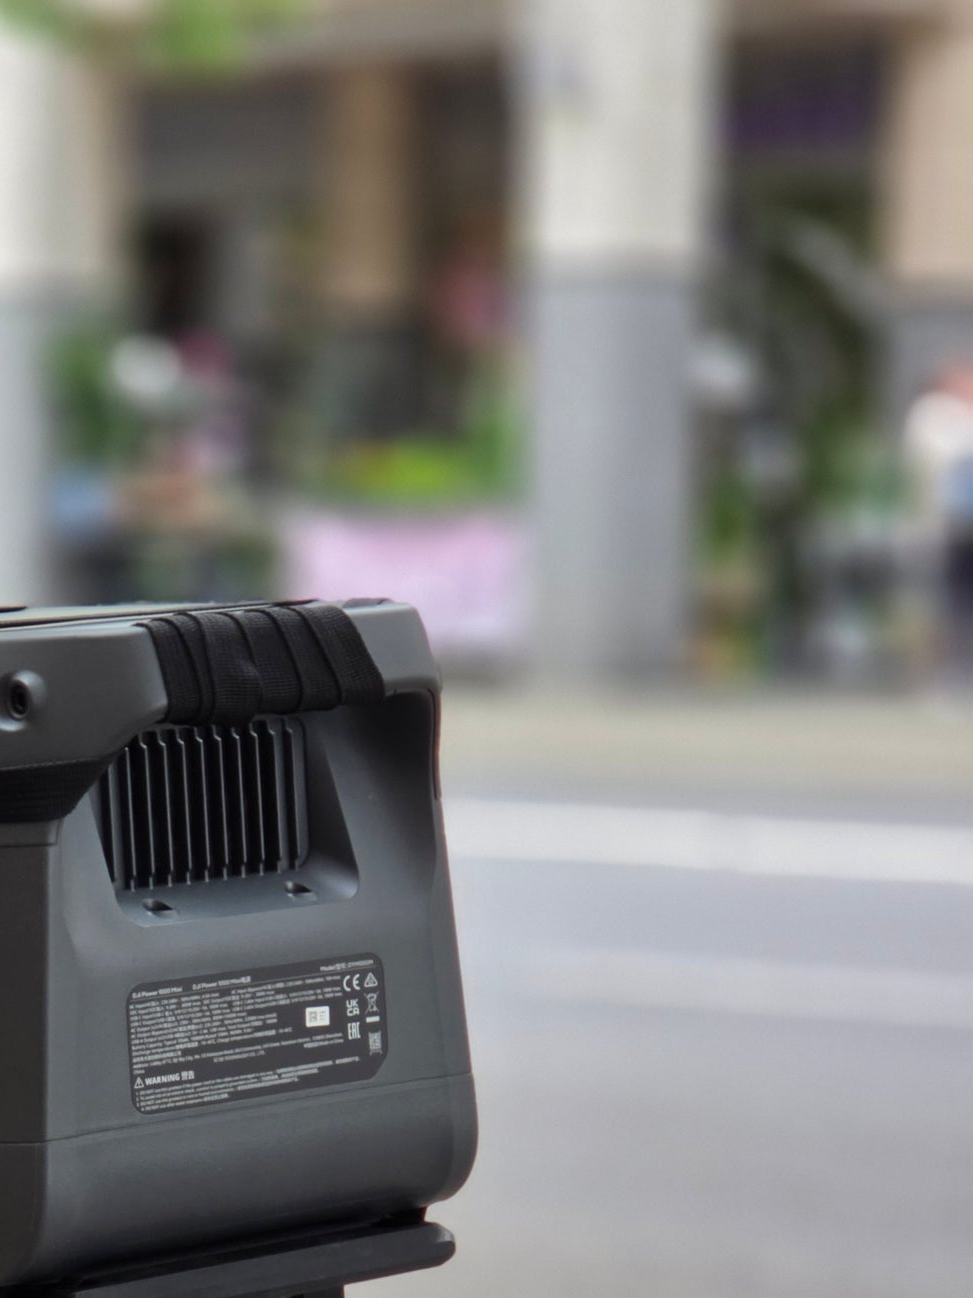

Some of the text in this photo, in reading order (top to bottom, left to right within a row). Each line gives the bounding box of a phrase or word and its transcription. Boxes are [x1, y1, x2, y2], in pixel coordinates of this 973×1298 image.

[346, 999, 359, 1008] UK
[347, 1007, 360, 1016] CA
[145, 1073, 180, 1085] WARNING
